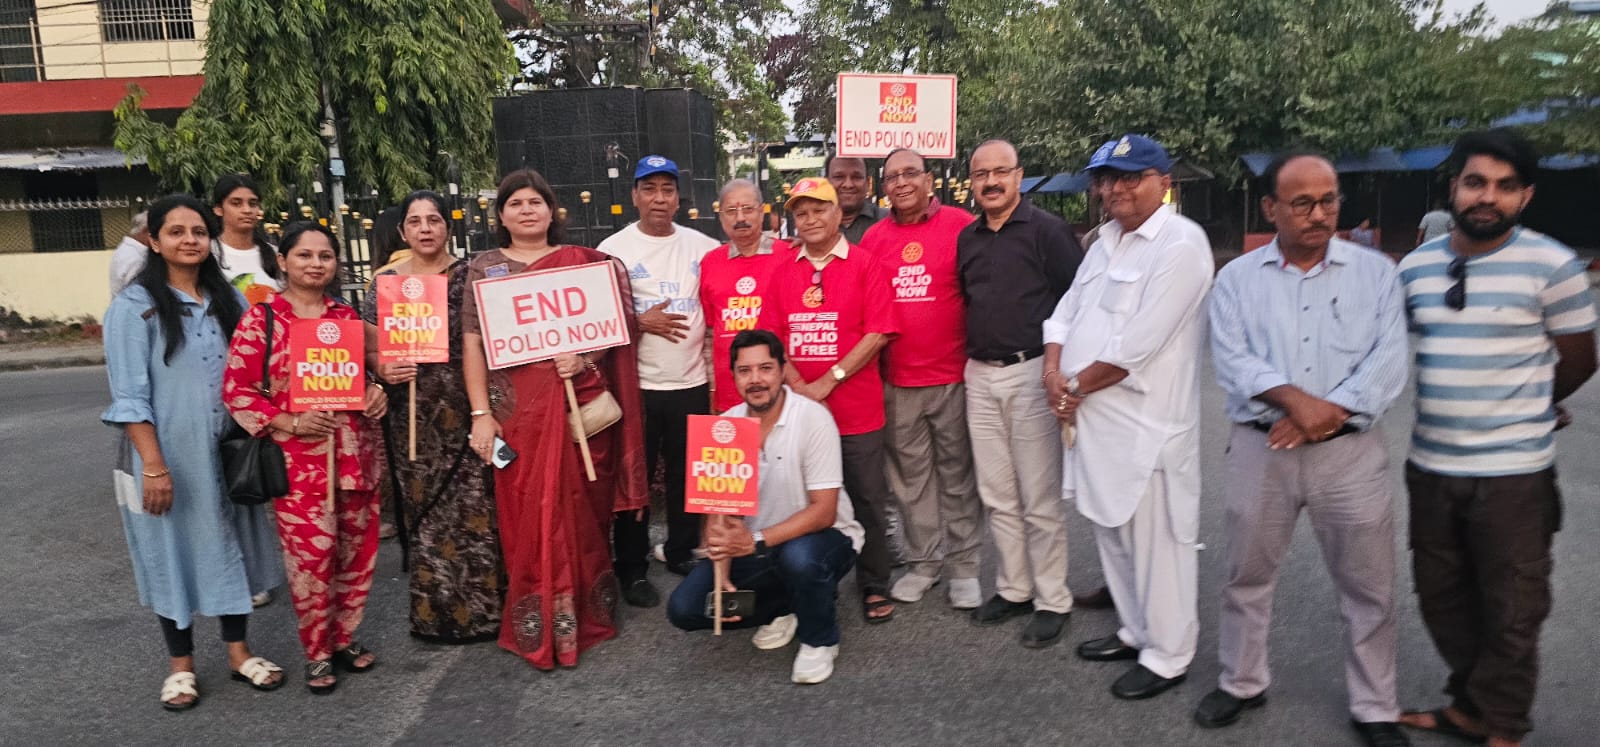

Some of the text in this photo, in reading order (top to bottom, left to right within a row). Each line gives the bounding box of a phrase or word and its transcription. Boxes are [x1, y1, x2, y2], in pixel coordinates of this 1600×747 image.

[885, 96, 913, 105] END
[880, 104, 918, 113] POLIO
[883, 112, 914, 122] NOW
[845, 130, 948, 149] END POLIO NOW
[898, 264, 926, 277] END
[659, 281, 680, 295] Fly
[891, 274, 932, 287] POLIO
[895, 285, 928, 298] NOW
[392, 302, 434, 317] END
[512, 286, 587, 325] END
[728, 296, 762, 309] END
[383, 315, 442, 331] POLIO
[788, 312, 815, 322] KEEP
[800, 321, 838, 331] NEPAL
[389, 329, 437, 344] NOW
[493, 318, 618, 358] POLIO NOW
[789, 331, 838, 356] POLIO
[306, 347, 350, 363] END
[801, 344, 838, 356] FREE
[296, 361, 359, 377] POLIO
[303, 375, 353, 391] NOW
[702, 447, 746, 464] END
[692, 461, 754, 480] POLIO
[697, 476, 747, 494] NOW
